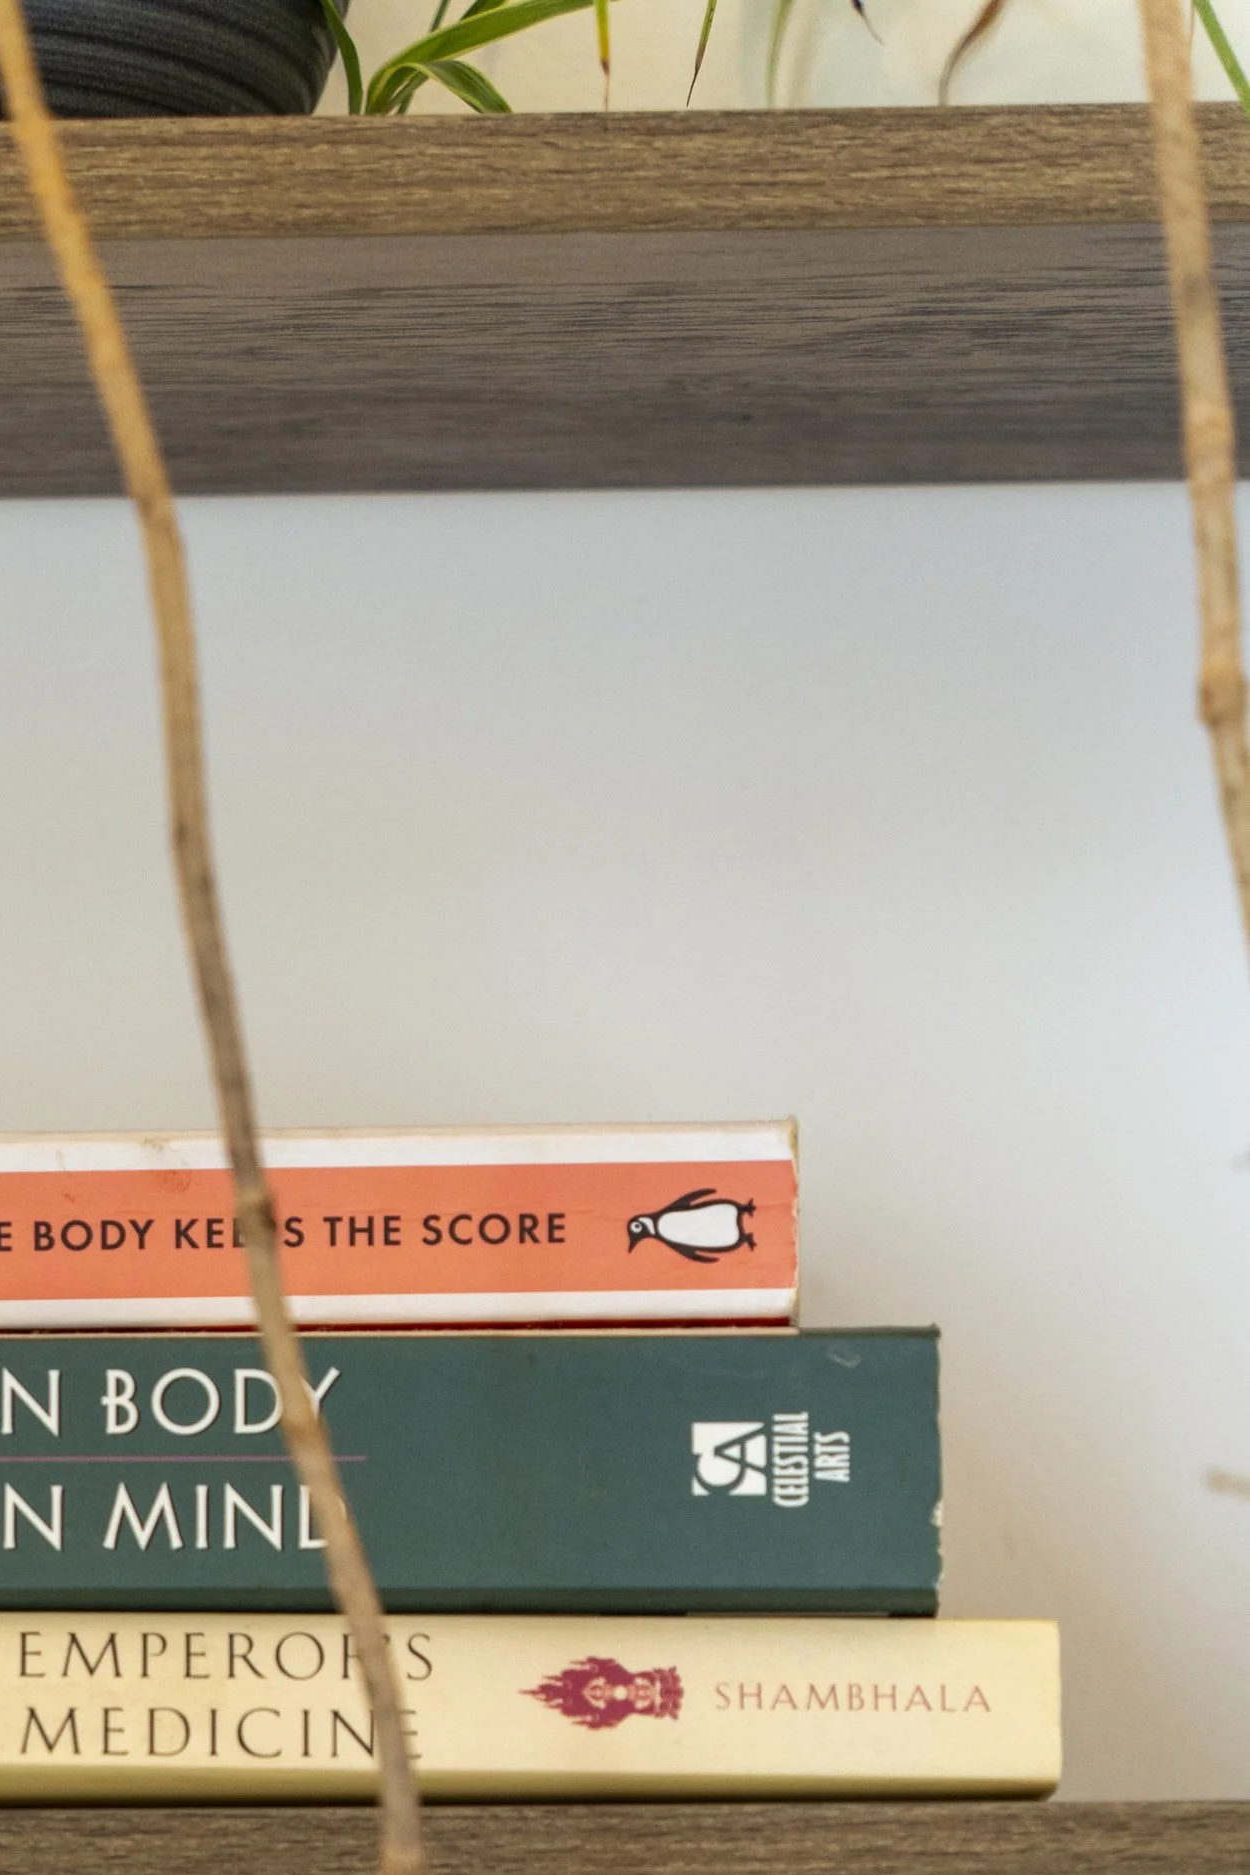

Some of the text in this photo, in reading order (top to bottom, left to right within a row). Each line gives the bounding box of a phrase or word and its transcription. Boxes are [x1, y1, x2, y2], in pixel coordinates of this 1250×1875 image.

[33, 1218, 155, 1252] BODY
[322, 1215, 402, 1247] THE
[421, 1212, 566, 1246] SCORE
[772, 1411, 809, 1507] CELESTIAL
[814, 1431, 850, 1482] ARTS
[714, 1681, 992, 1714] SHAMBHALA
